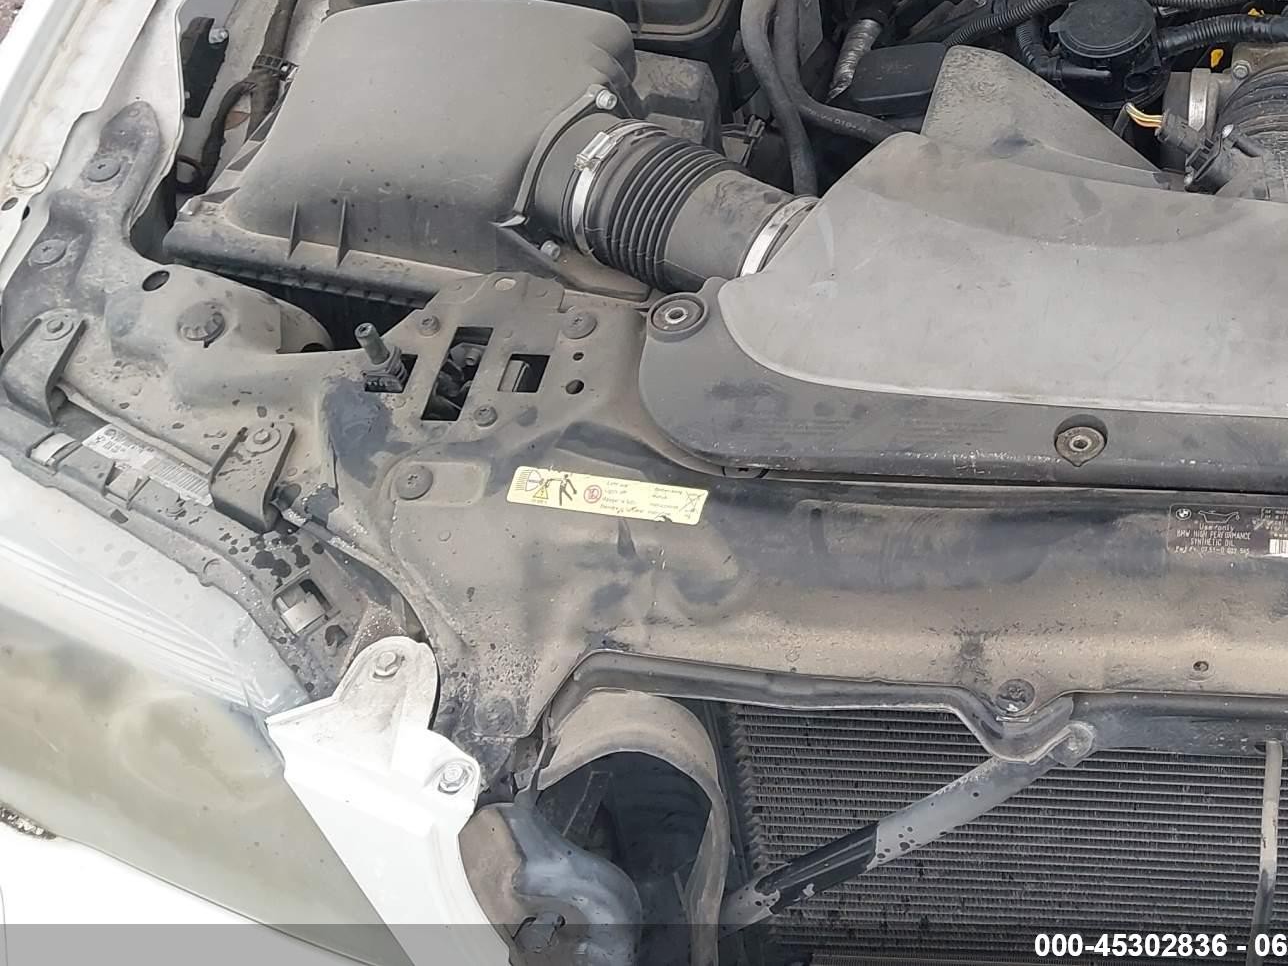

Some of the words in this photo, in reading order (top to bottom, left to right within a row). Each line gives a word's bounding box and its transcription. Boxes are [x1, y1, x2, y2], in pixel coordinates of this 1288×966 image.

[1177, 530, 1191, 538] BMW
[1193, 530, 1208, 538] HIGH
[1209, 531, 1251, 540] PERFORMANCE
[1190, 537, 1222, 546] SYNTHETIC
